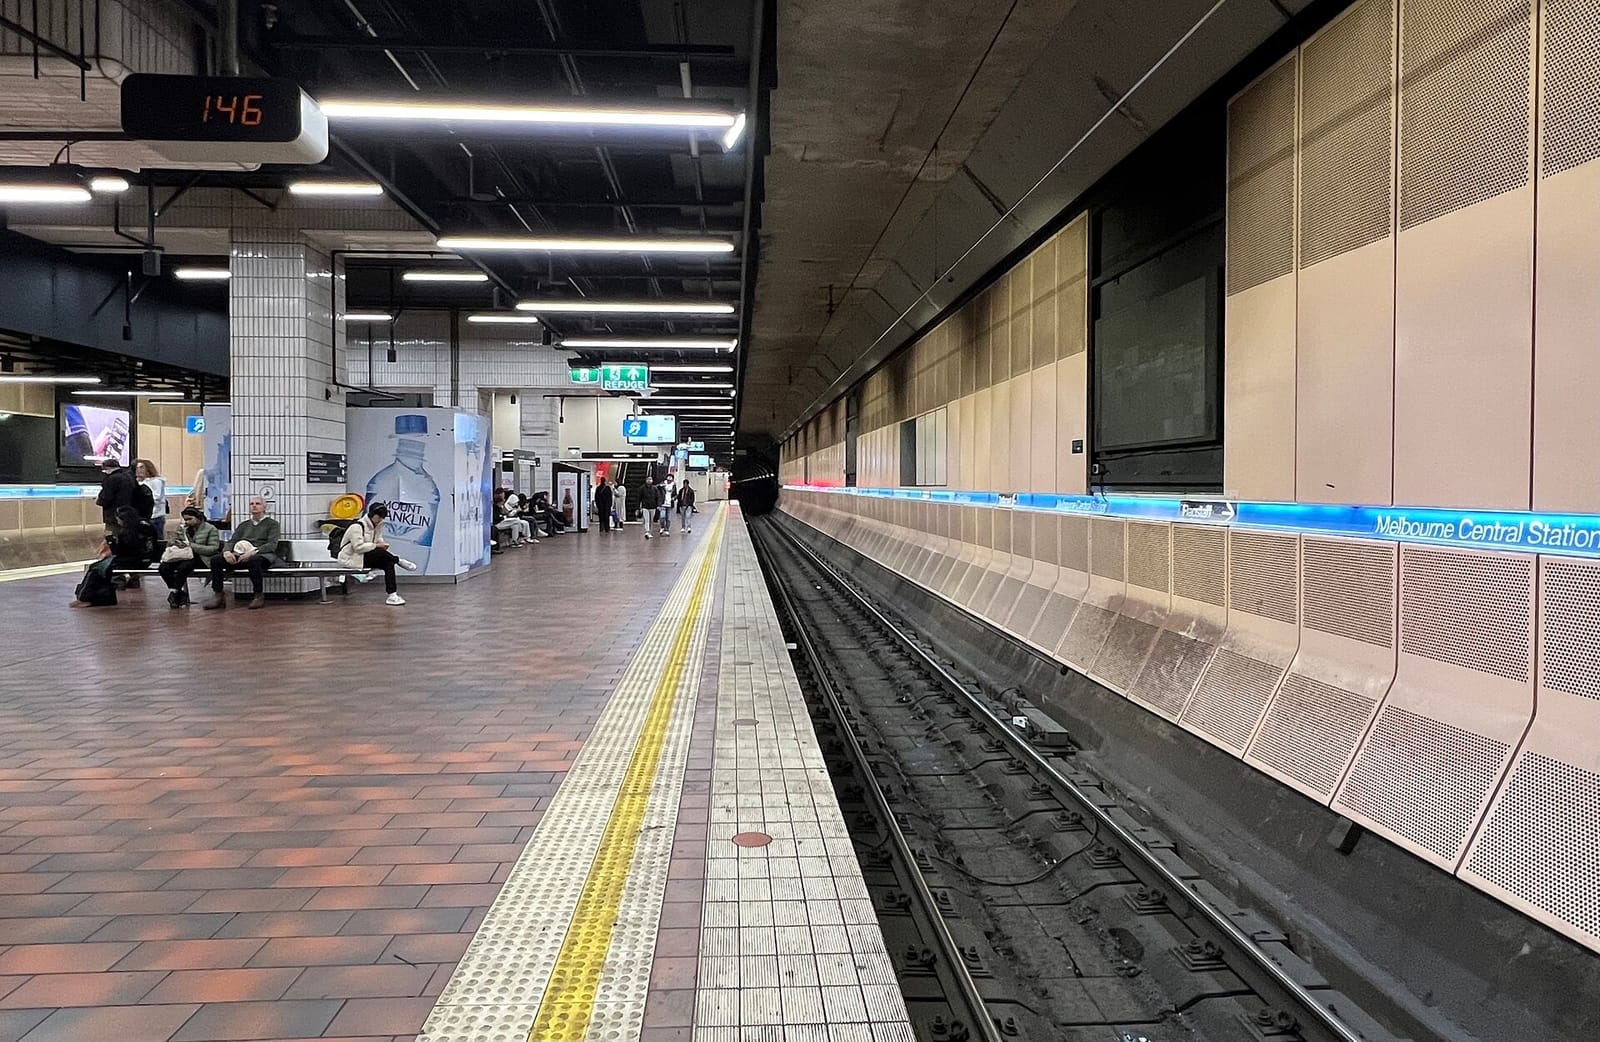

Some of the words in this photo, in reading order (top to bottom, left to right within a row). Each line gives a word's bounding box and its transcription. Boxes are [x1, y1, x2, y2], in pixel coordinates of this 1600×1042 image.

[604, 380, 645, 389] REFUGE
[383, 499, 424, 514] MOUNT
[386, 511, 431, 528] ANKLIN
[1375, 515, 1454, 539] Melbourne
[1458, 518, 1523, 543] Central
[1527, 521, 1600, 548] Station
